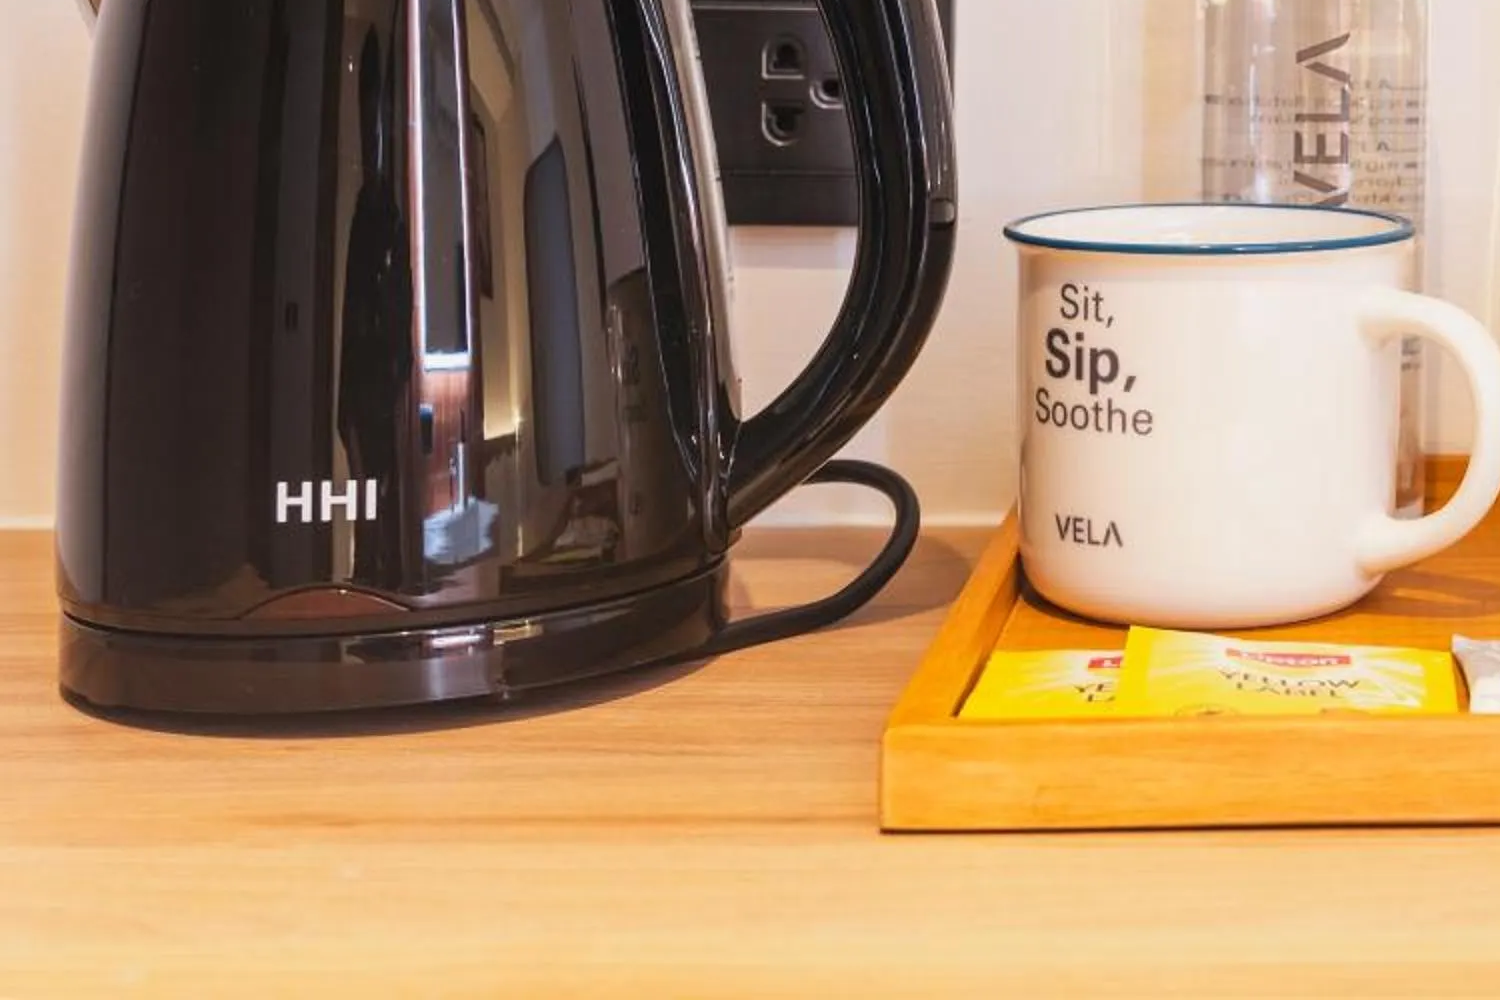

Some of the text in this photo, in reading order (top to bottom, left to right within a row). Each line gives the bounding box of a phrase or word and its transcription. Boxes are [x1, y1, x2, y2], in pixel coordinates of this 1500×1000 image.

[1293, 32, 1351, 206] VELA
[1059, 283, 1115, 328] Sit,
[1044, 328, 1137, 394] Sip,
[1034, 387, 1154, 436] Soothe
[276, 478, 377, 522] HHI
[1055, 513, 1123, 548] VELA
[1219, 668, 1360, 689] YELLOW
